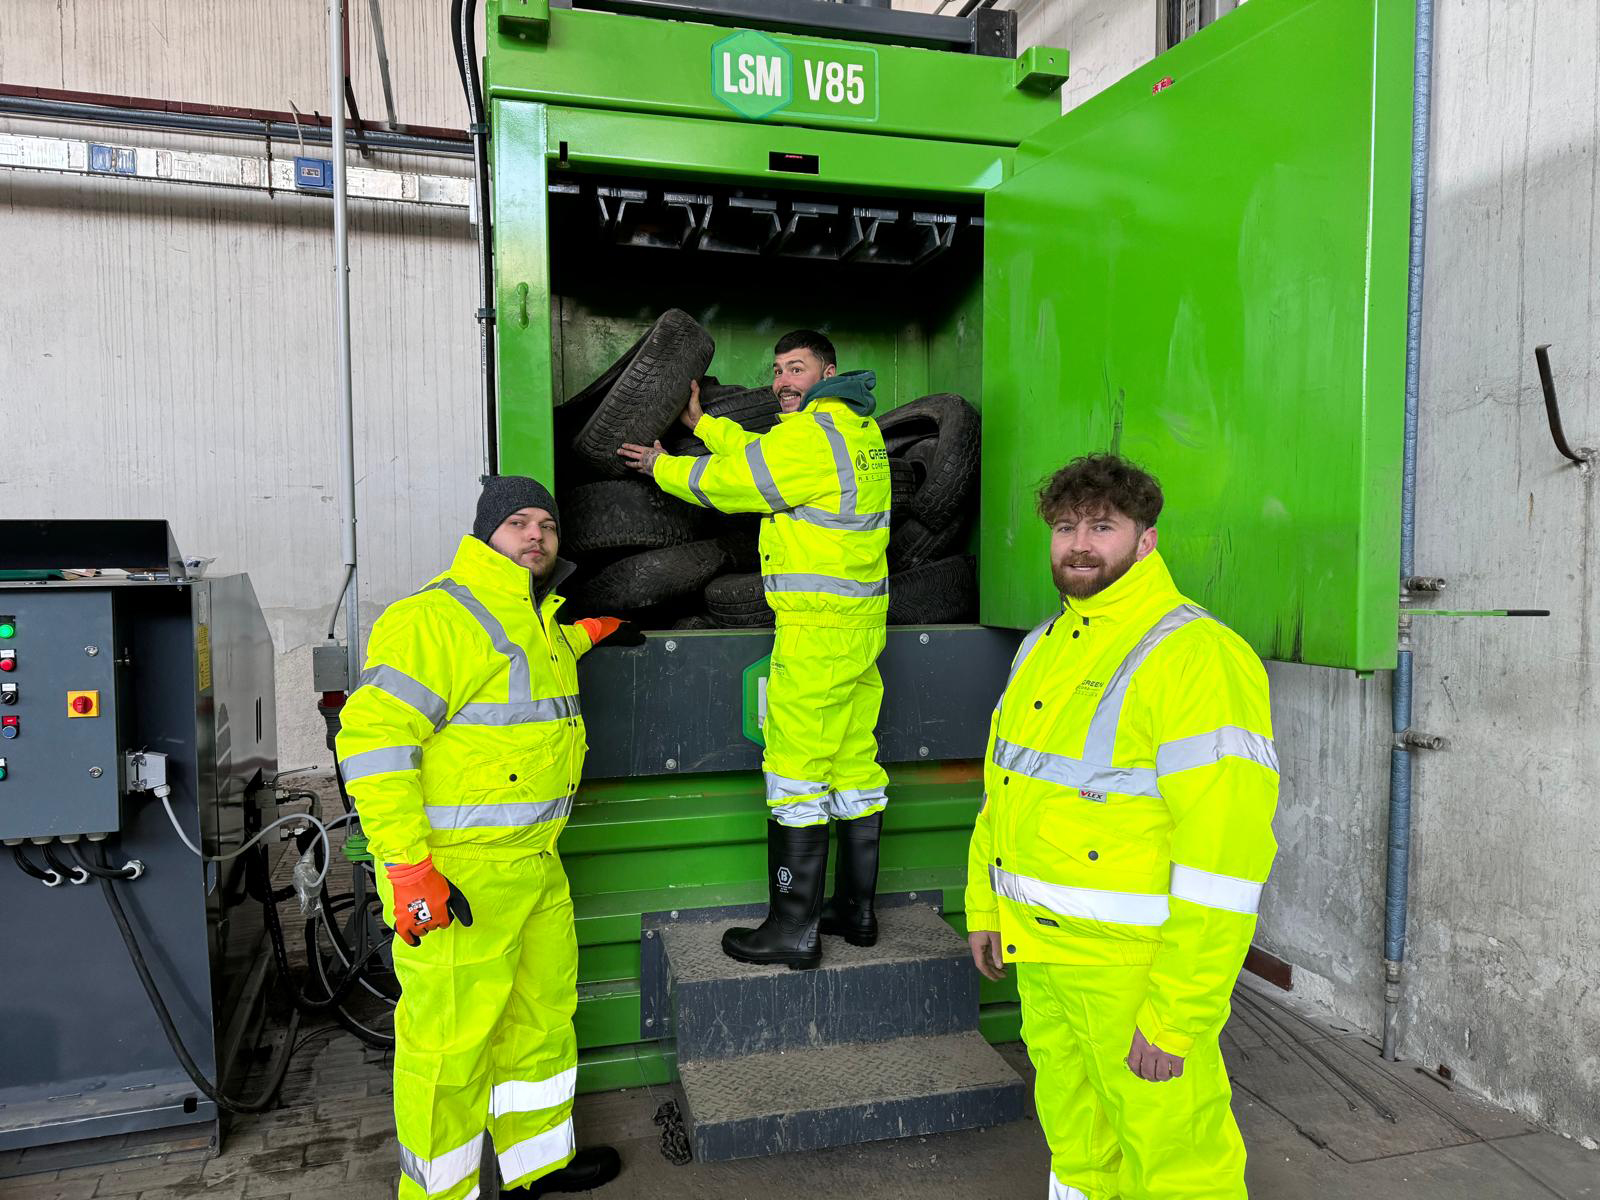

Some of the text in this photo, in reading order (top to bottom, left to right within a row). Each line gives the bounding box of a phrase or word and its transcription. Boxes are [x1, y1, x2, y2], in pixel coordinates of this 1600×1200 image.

[723, 51, 782, 97] LSM
[803, 59, 865, 105] V85
[868, 448, 888, 460] GREE
